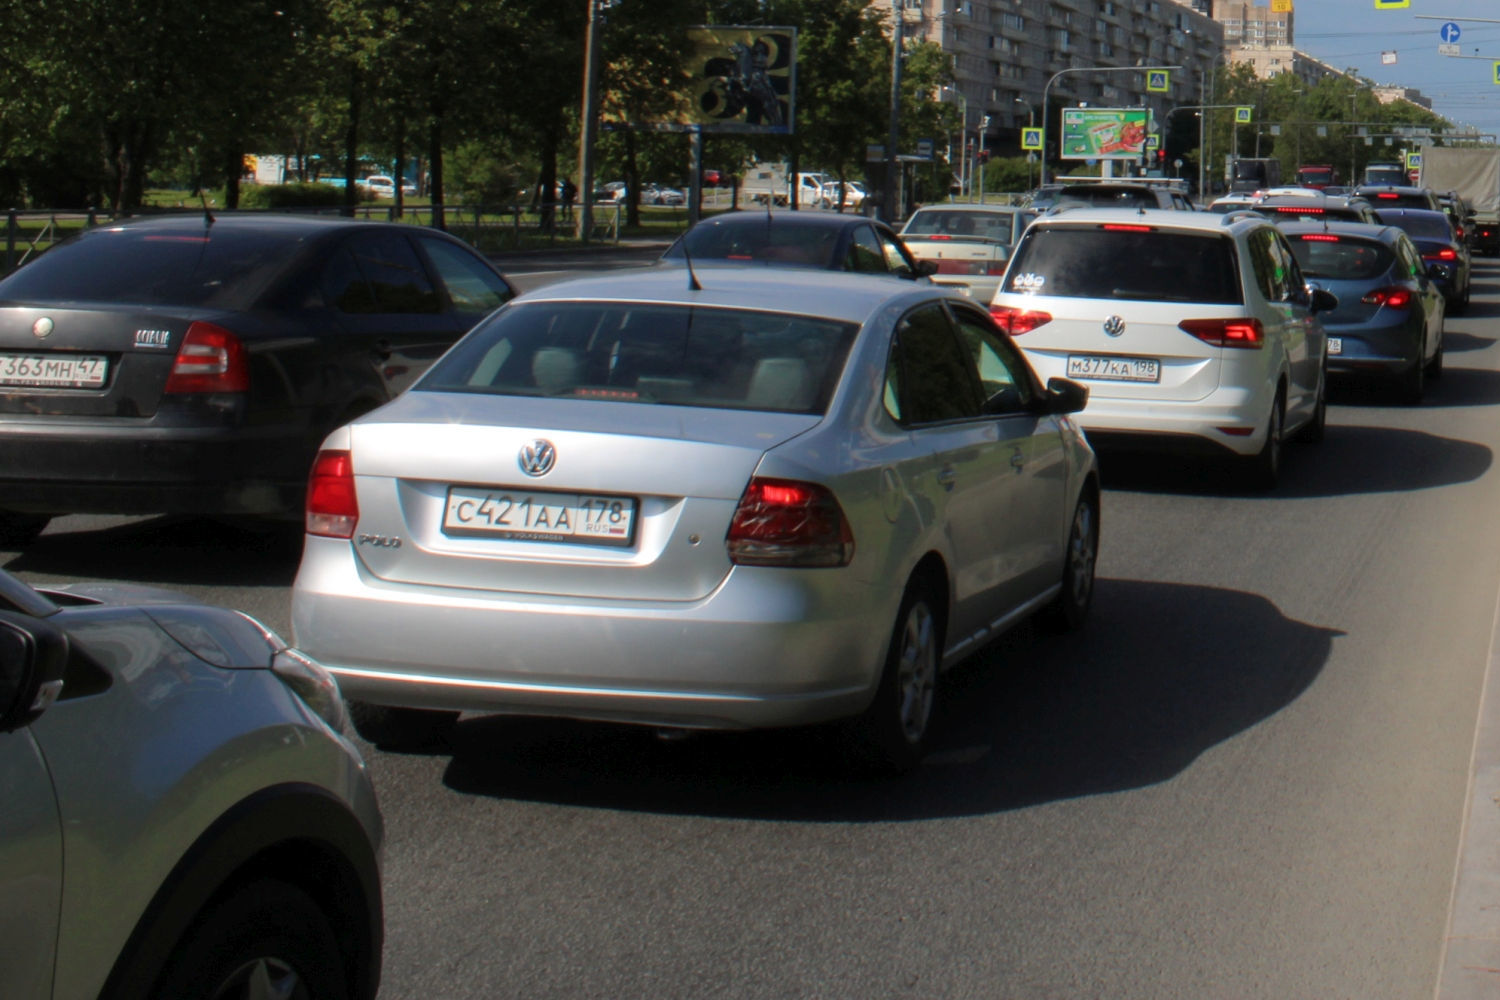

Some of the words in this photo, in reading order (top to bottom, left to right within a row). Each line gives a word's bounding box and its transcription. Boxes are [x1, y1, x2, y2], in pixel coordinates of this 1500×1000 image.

[0, 355, 72, 378] 363МН
[78, 357, 99, 374] 47
[1072, 358, 1129, 376] М377КА
[1135, 360, 1155, 373] 198
[456, 494, 571, 530] С421АА
[580, 498, 623, 524] 178
[359, 534, 402, 547] POLO
